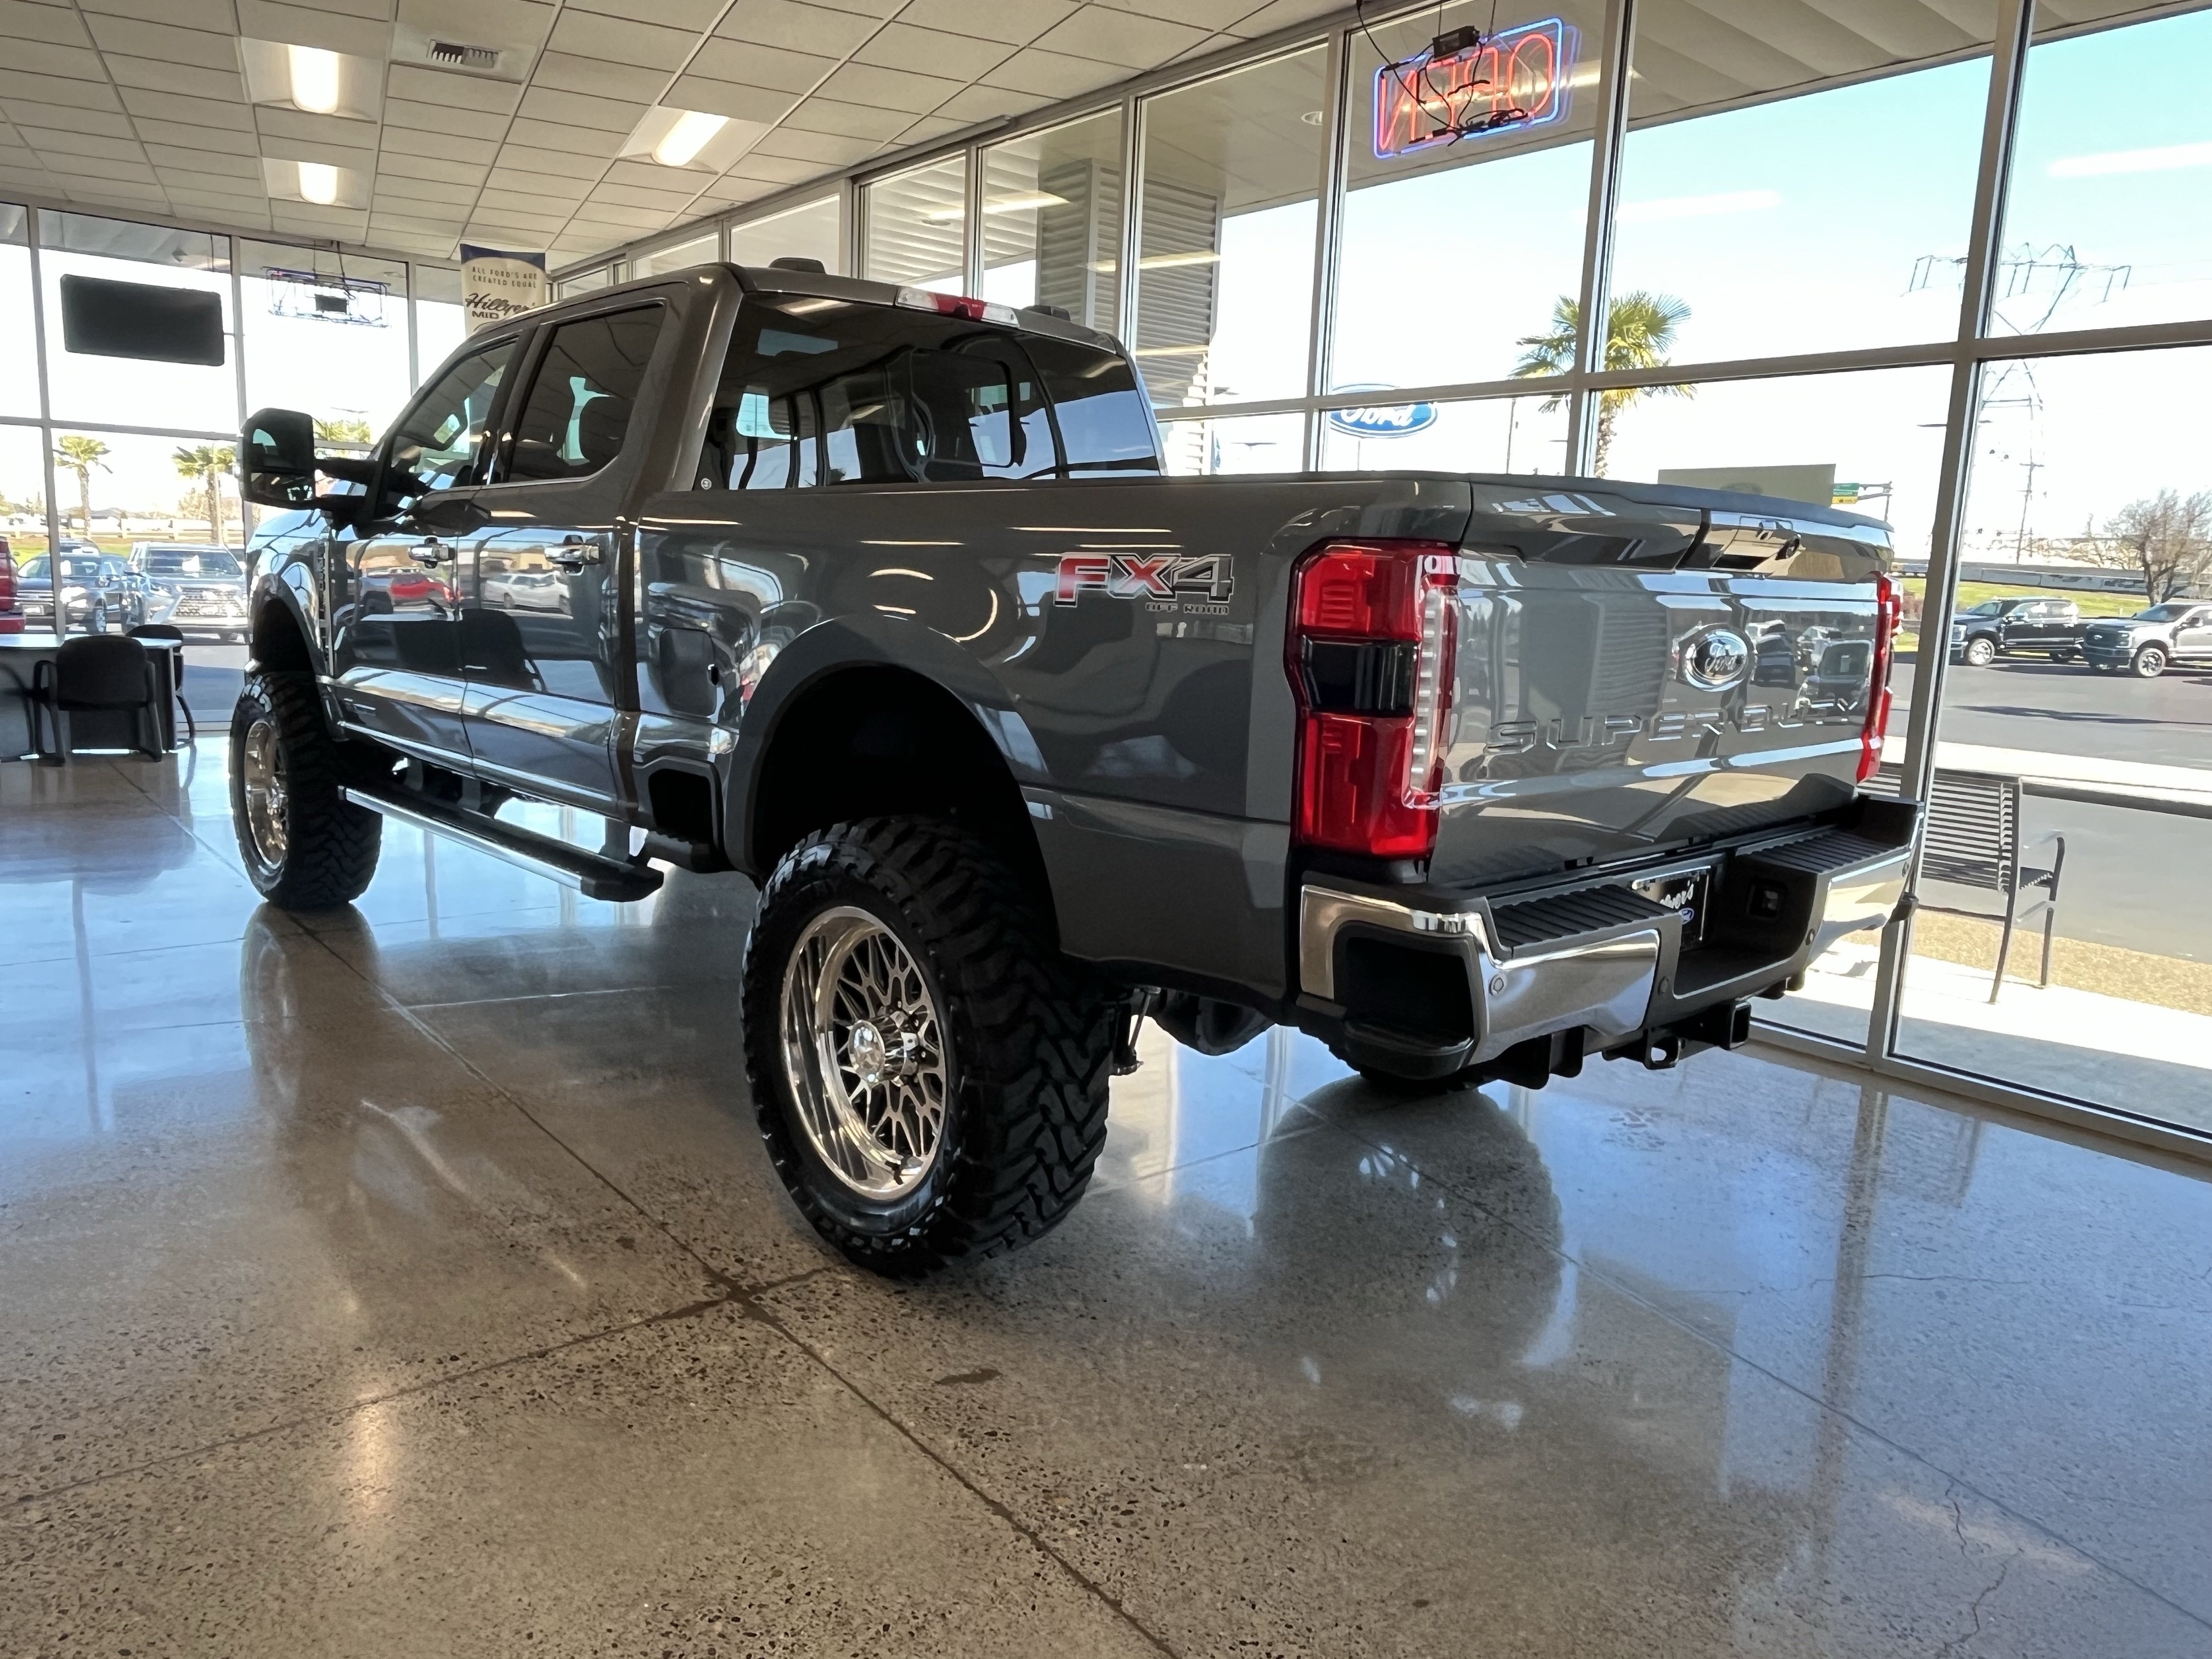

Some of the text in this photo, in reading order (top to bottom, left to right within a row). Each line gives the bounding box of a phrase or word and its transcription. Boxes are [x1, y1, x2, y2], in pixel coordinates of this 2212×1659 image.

[472, 266, 486, 274] ALL
[473, 274, 537, 289] CREATED EQUAL
[472, 311, 499, 319] MID
[1053, 551, 1235, 608] FX4
[1145, 602, 1229, 616] OFF ROAD
[1483, 697, 1859, 754] SUPER DUTY
